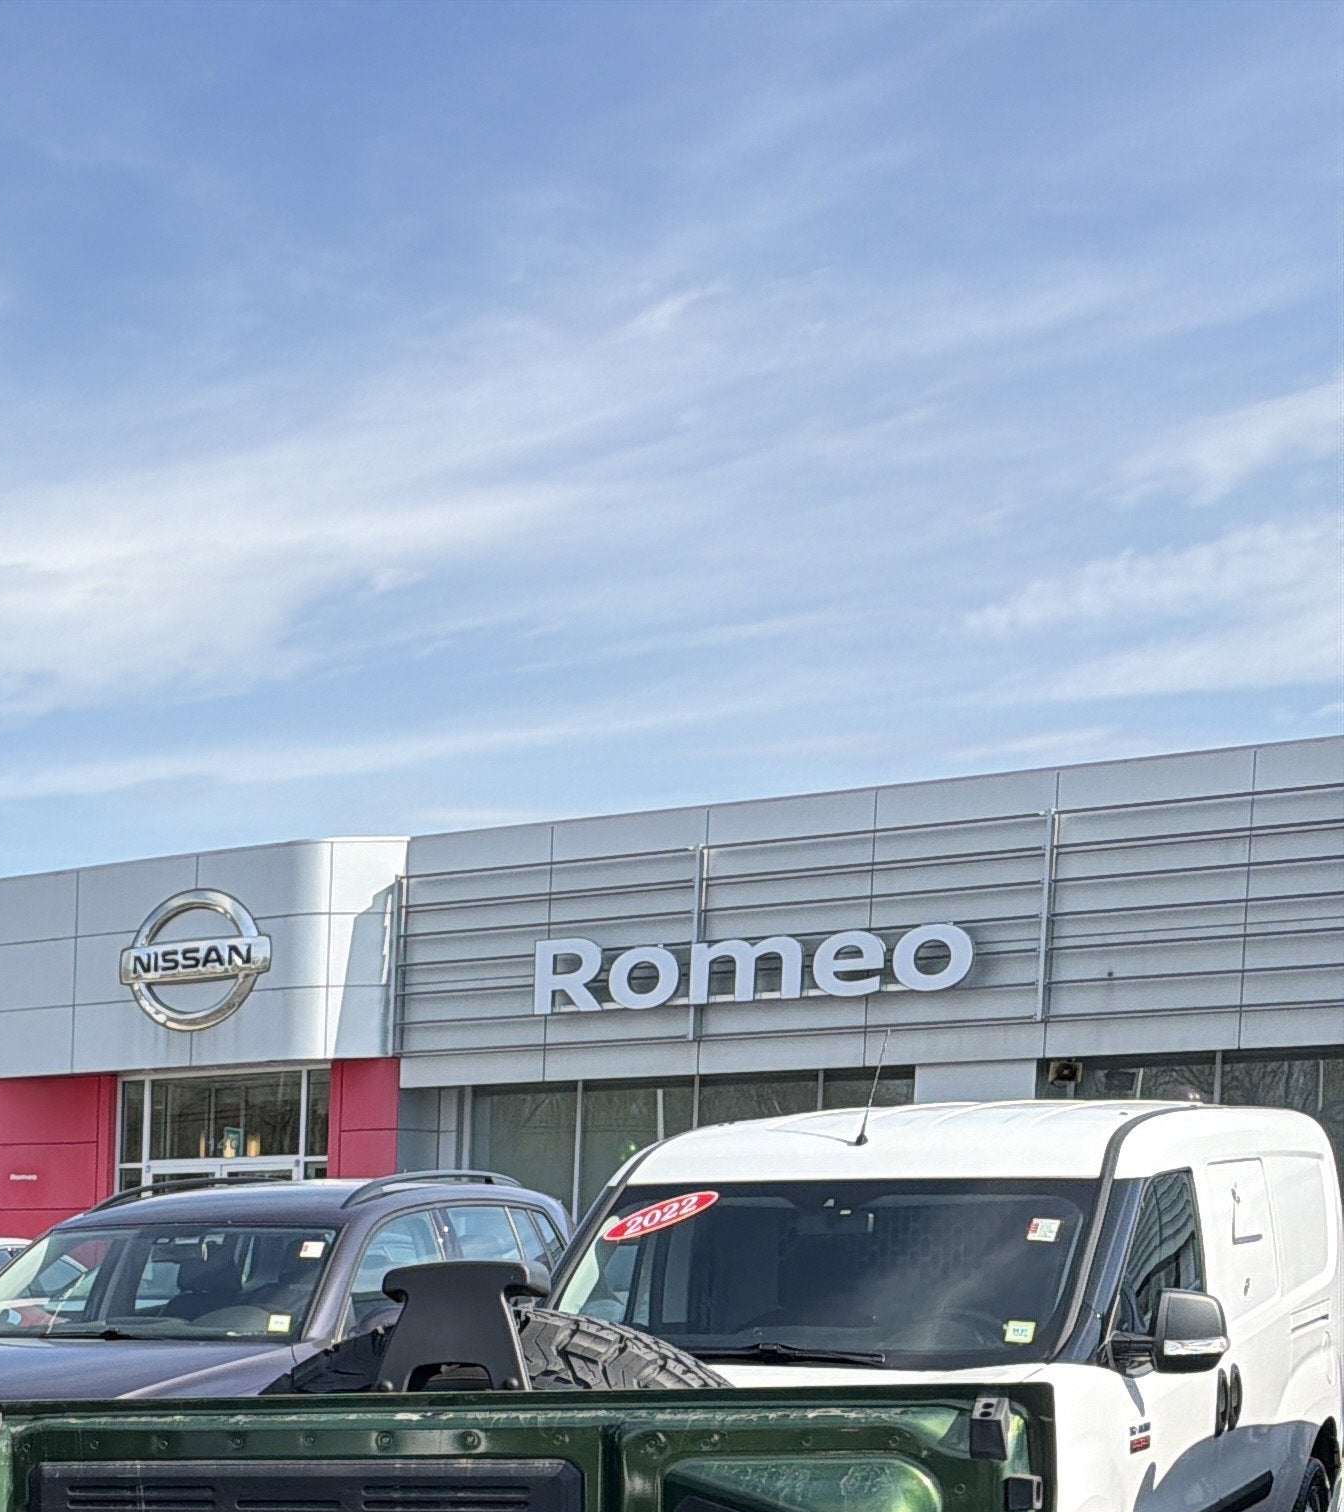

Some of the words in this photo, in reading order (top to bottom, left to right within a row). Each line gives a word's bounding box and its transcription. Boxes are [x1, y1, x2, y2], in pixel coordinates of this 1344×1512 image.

[133, 943, 252, 975] NISSAN
[533, 922, 976, 1015] Romeo
[624, 1195, 699, 1237] 2022
